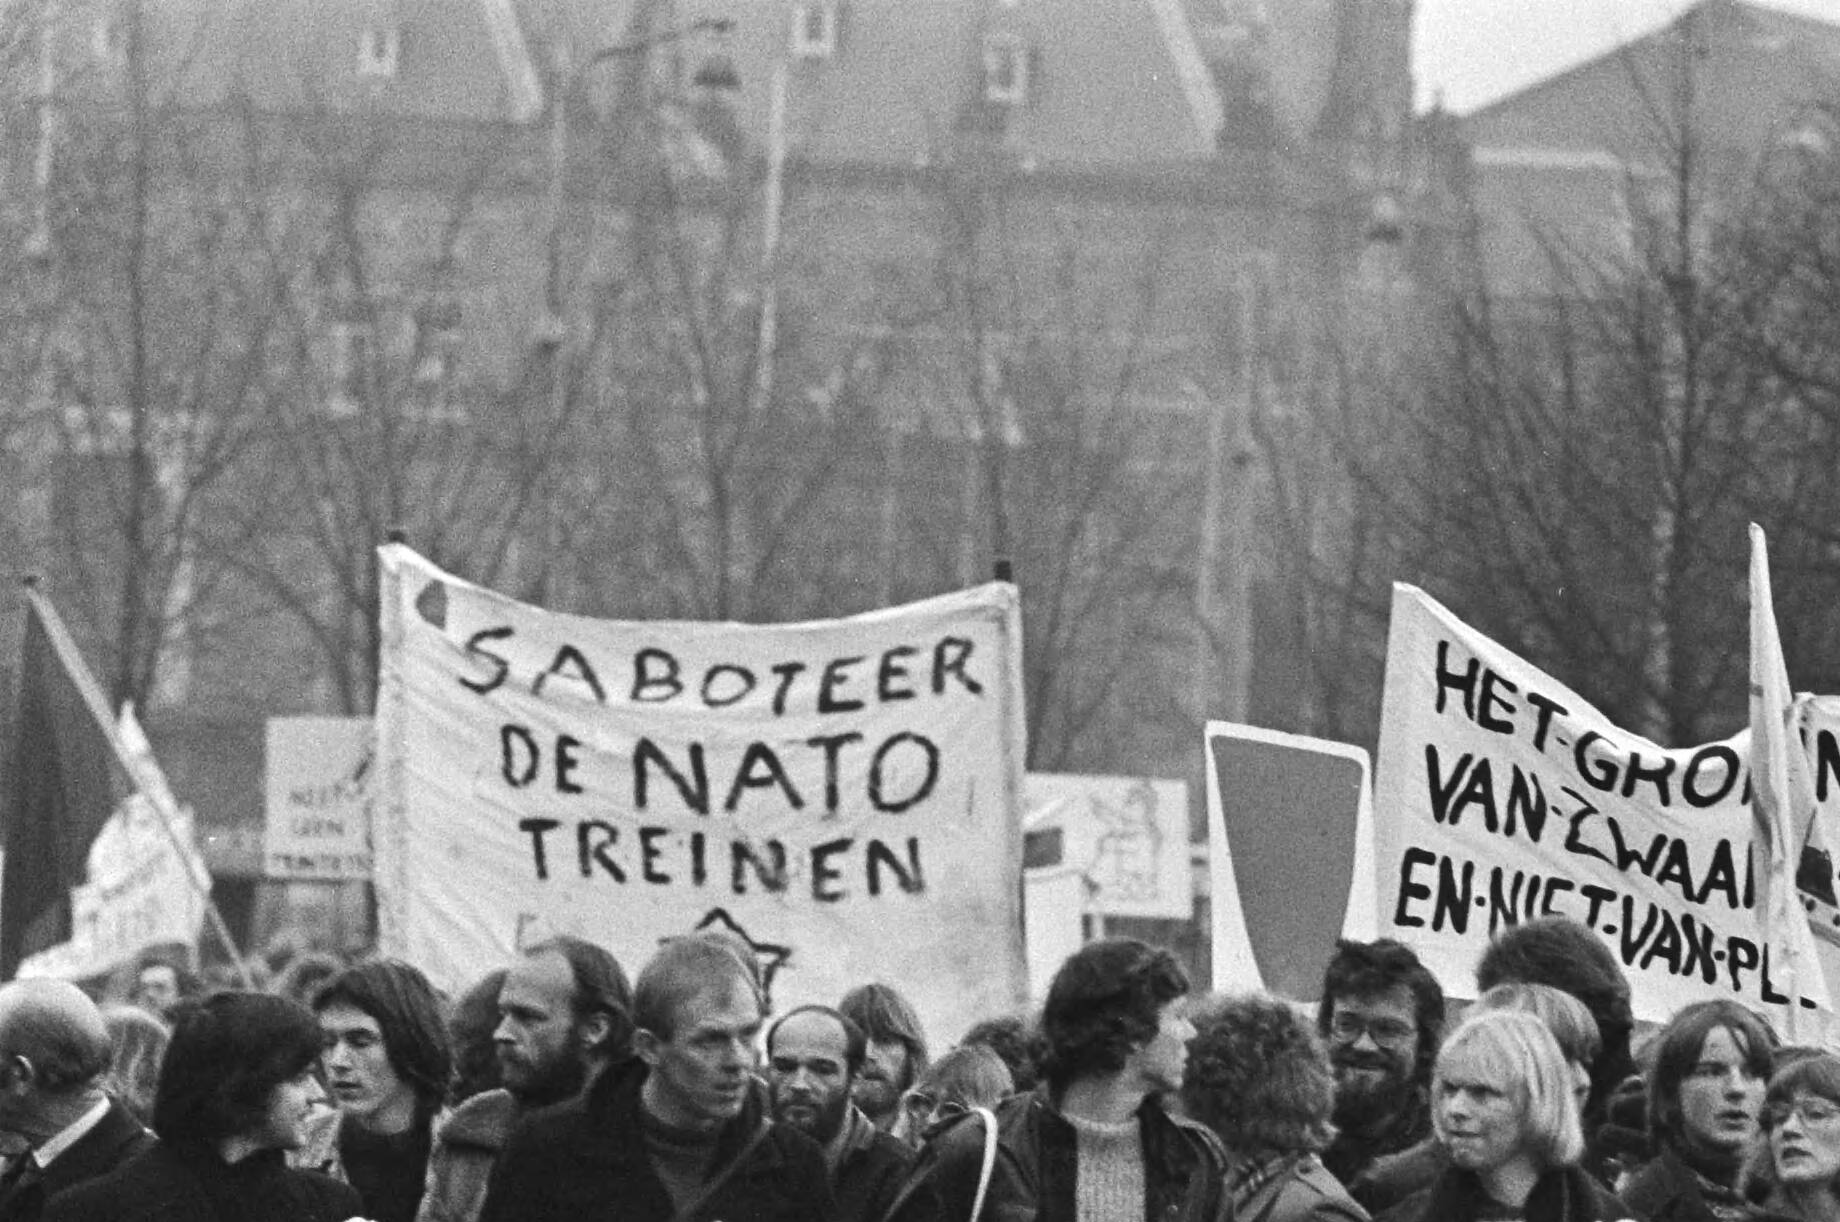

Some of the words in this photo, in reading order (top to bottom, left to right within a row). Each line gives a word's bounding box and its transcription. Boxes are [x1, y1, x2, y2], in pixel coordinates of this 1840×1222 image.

[460, 627, 983, 715] SABOTEER
[501, 724, 582, 794] DE
[633, 732, 940, 815] NATO
[519, 818, 924, 901] TREINEN
